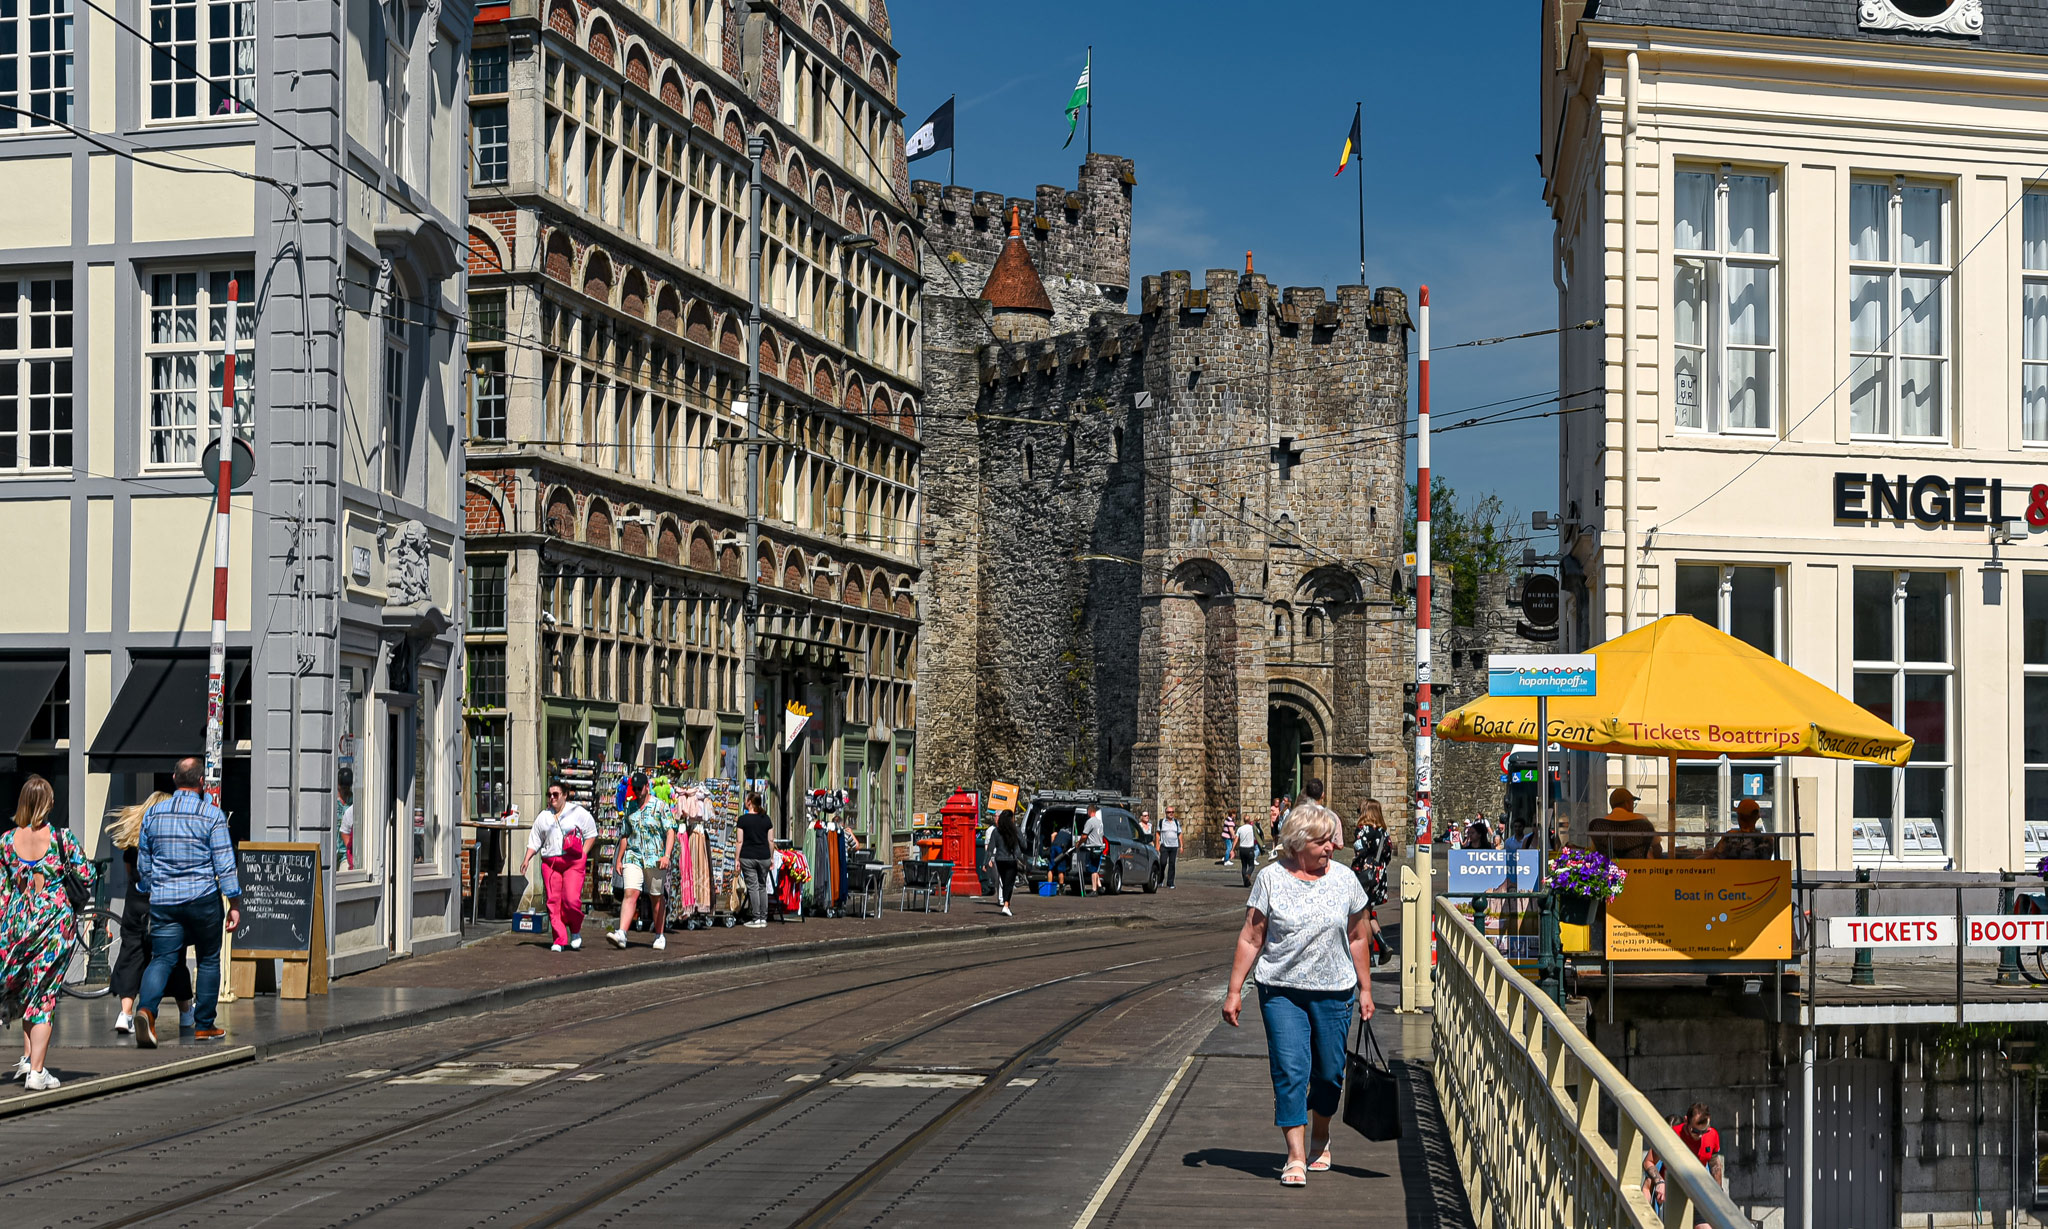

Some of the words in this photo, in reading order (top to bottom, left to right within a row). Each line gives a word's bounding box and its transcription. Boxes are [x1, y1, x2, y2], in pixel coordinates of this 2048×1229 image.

[1834, 472, 2022, 524] ENGEL
[2026, 484, 2048, 526] &
[1474, 715, 1514, 735] Boat
[1518, 717, 1536, 734] in
[1547, 720, 1595, 743] Gent
[1628, 722, 1701, 742] Tickets
[1708, 724, 1801, 748] Boattrips
[1818, 731, 1841, 752] Boat
[1843, 740, 1857, 754] in
[1862, 739, 1897, 762] Gent
[1525, 770, 1533, 780] 4
[1467, 852, 1520, 861] TICKETS
[1460, 866, 1494, 875] BOAT
[1495, 866, 1530, 875] TRIPS
[1649, 867, 1673, 875] pittige
[1674, 888, 1700, 901] Boat
[1704, 889, 1713, 901] in
[1718, 888, 1746, 901] Gent
[1848, 922, 1938, 942] TICKETS
[1971, 921, 2048, 941] BOOTT
